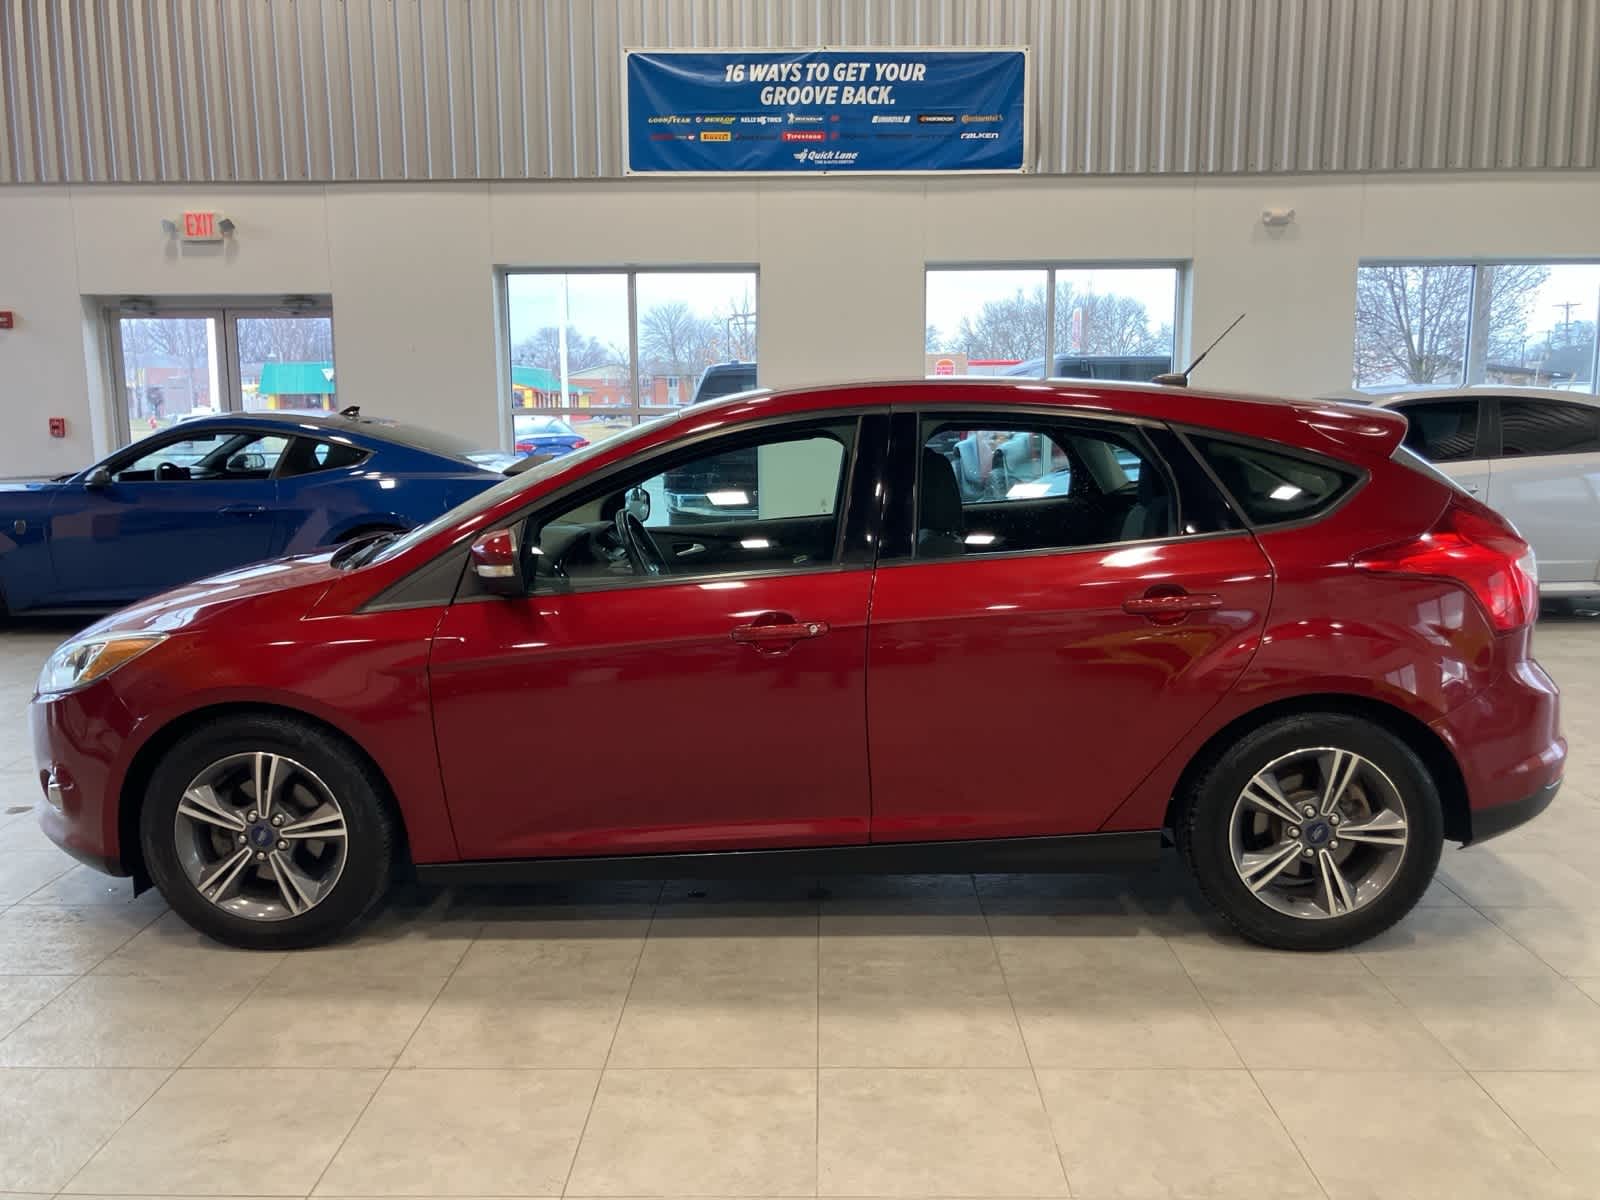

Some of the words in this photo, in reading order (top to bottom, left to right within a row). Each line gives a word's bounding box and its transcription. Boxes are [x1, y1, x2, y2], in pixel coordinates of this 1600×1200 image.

[724, 63, 745, 82] 16
[750, 63, 802, 82] WAYS
[806, 62, 829, 82] TO
[833, 63, 870, 82] GET
[875, 63, 926, 82] YOUR
[760, 86, 838, 106] GROOVE
[841, 86, 896, 105] BACK.
[648, 115, 691, 124] GOODYEAR
[960, 132, 999, 140] FALKEN
[807, 150, 834, 161] Quick
[834, 150, 859, 160] Lane
[183, 211, 214, 237] EXIT
